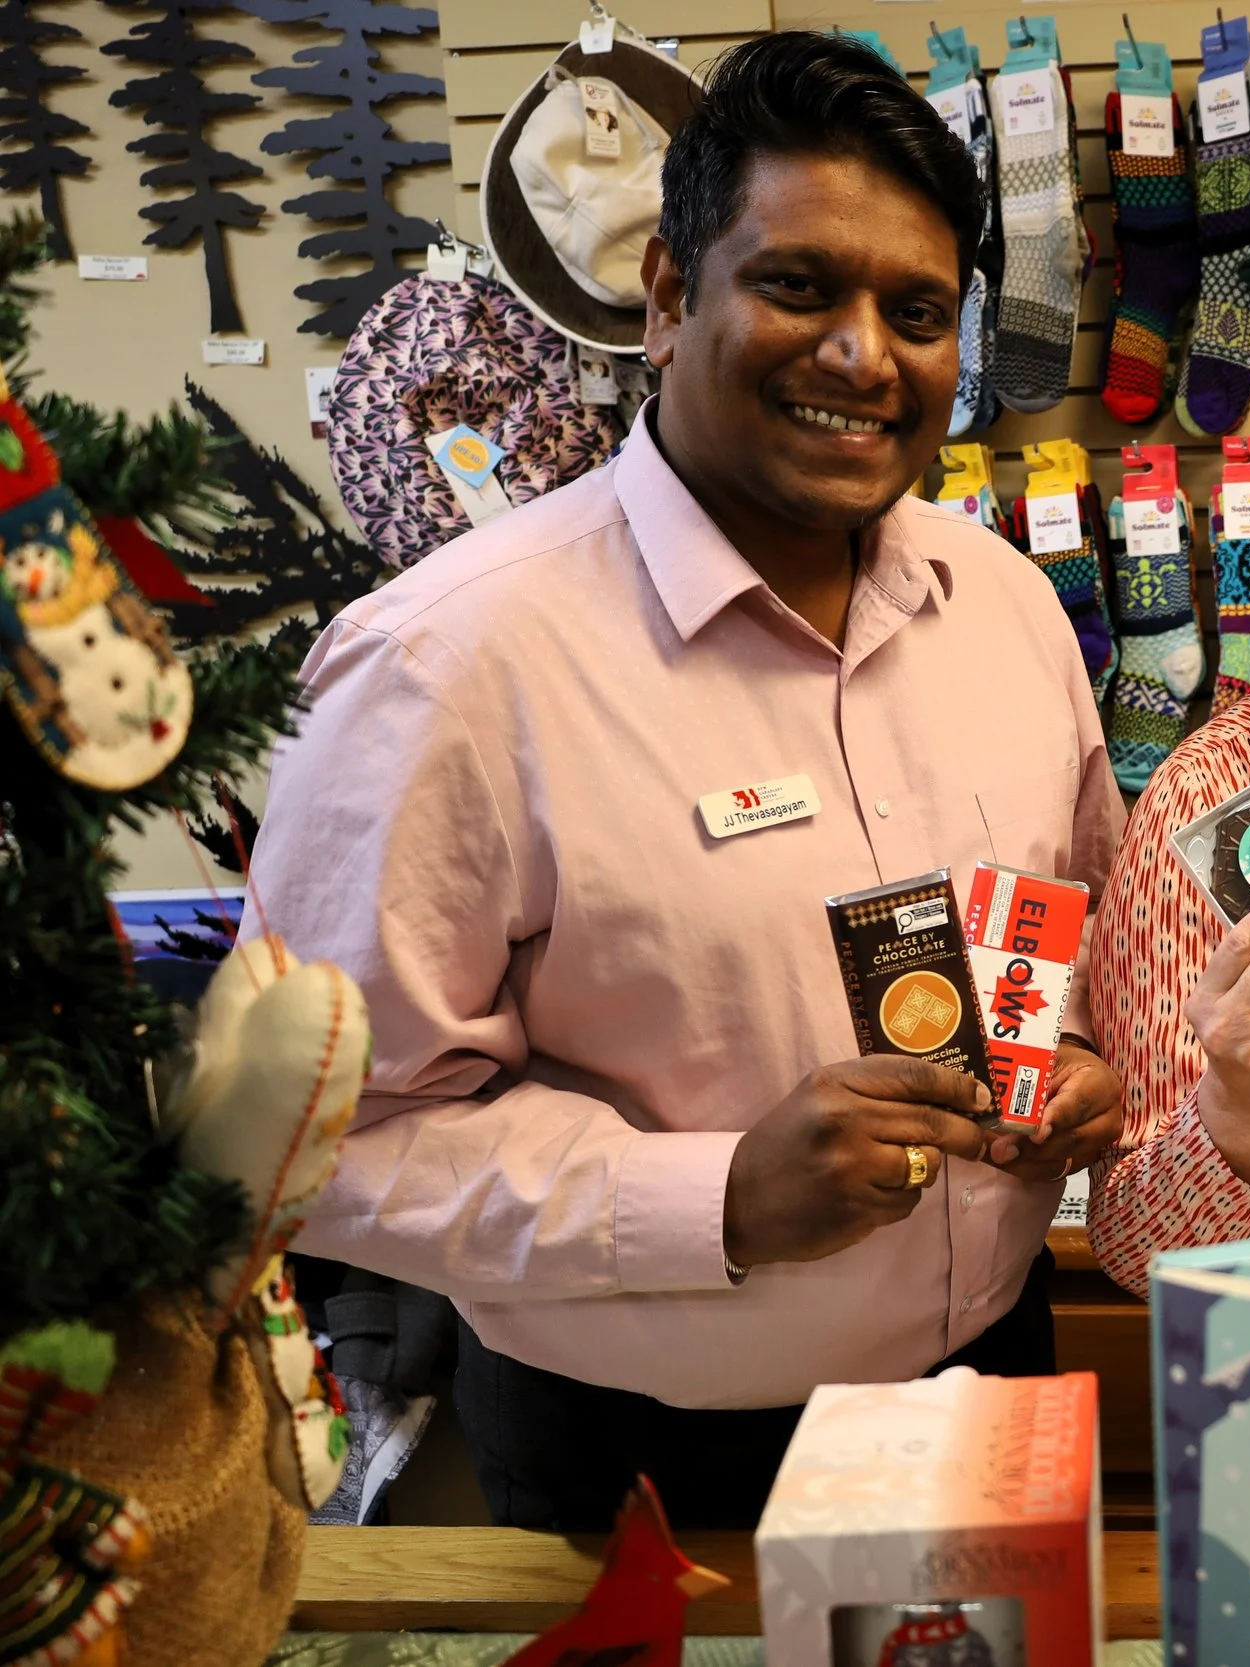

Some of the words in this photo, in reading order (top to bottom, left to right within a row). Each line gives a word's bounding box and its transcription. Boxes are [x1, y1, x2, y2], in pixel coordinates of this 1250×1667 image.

[1129, 120, 1166, 129] Solmate
[1035, 517, 1072, 529] Solmate
[1132, 521, 1170, 531] Solmate
[724, 815, 735, 827] JJ
[735, 799, 807, 824] Thevasagayam
[921, 931, 935, 942] BY
[993, 898, 1047, 1040] ELBOWS
